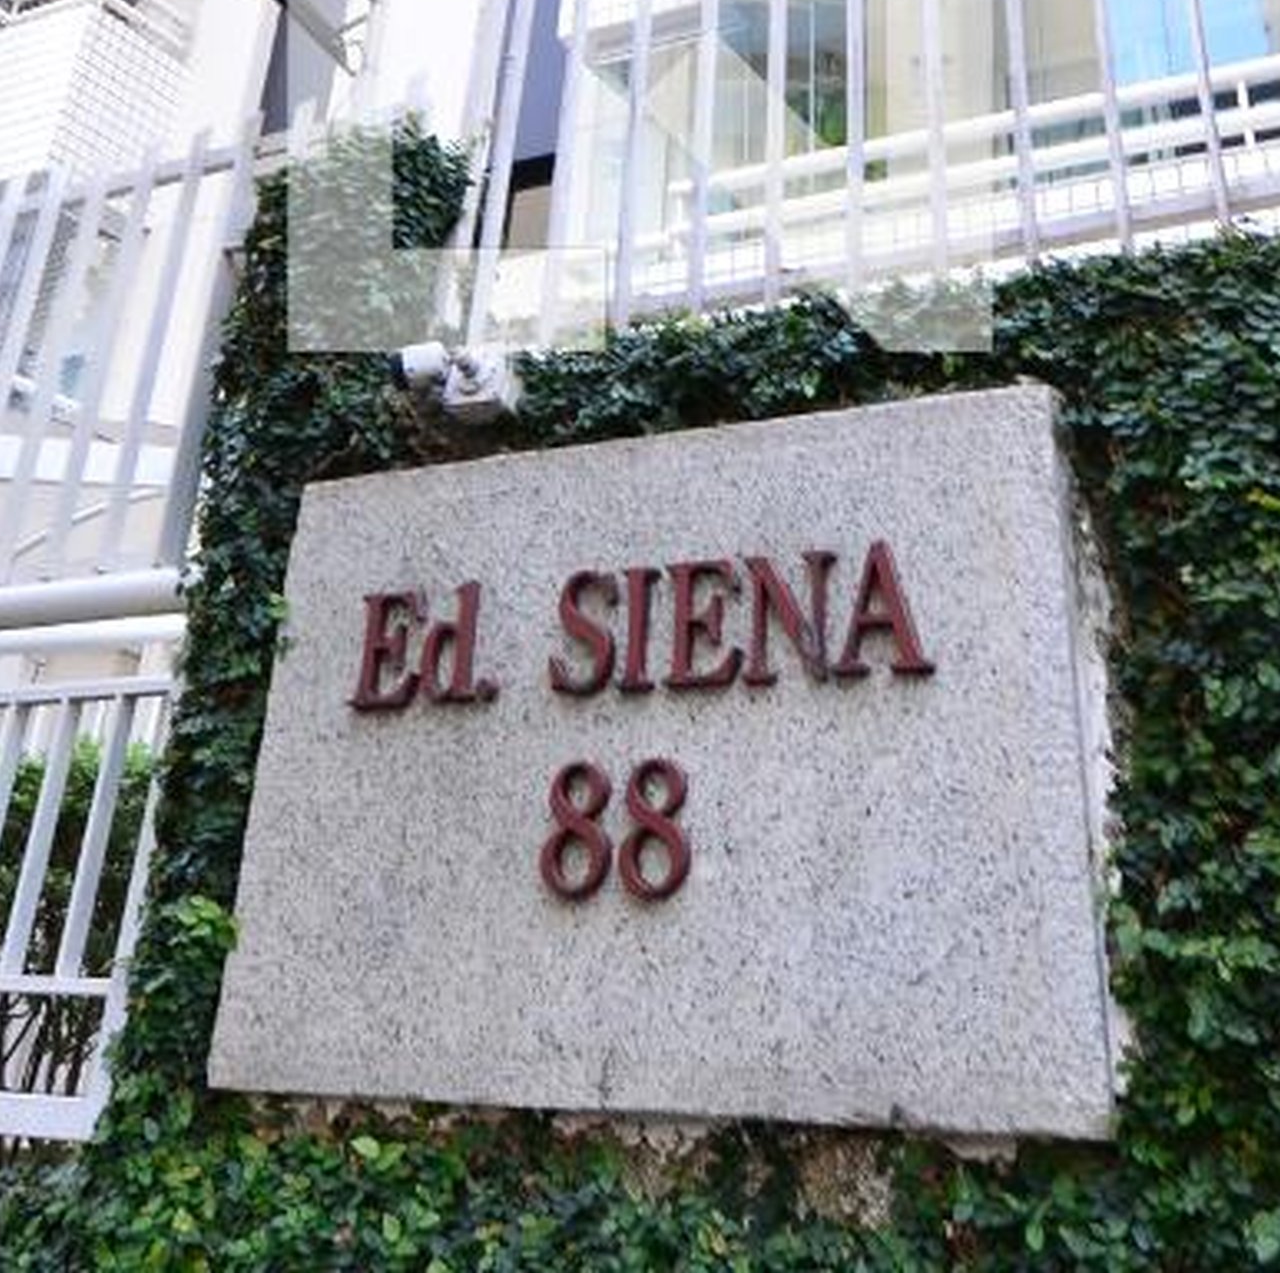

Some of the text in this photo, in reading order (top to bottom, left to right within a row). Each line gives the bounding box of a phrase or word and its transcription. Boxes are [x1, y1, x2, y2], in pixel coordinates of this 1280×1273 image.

[347, 539, 936, 712] Ed. SIENA
[538, 758, 692, 902] 88
